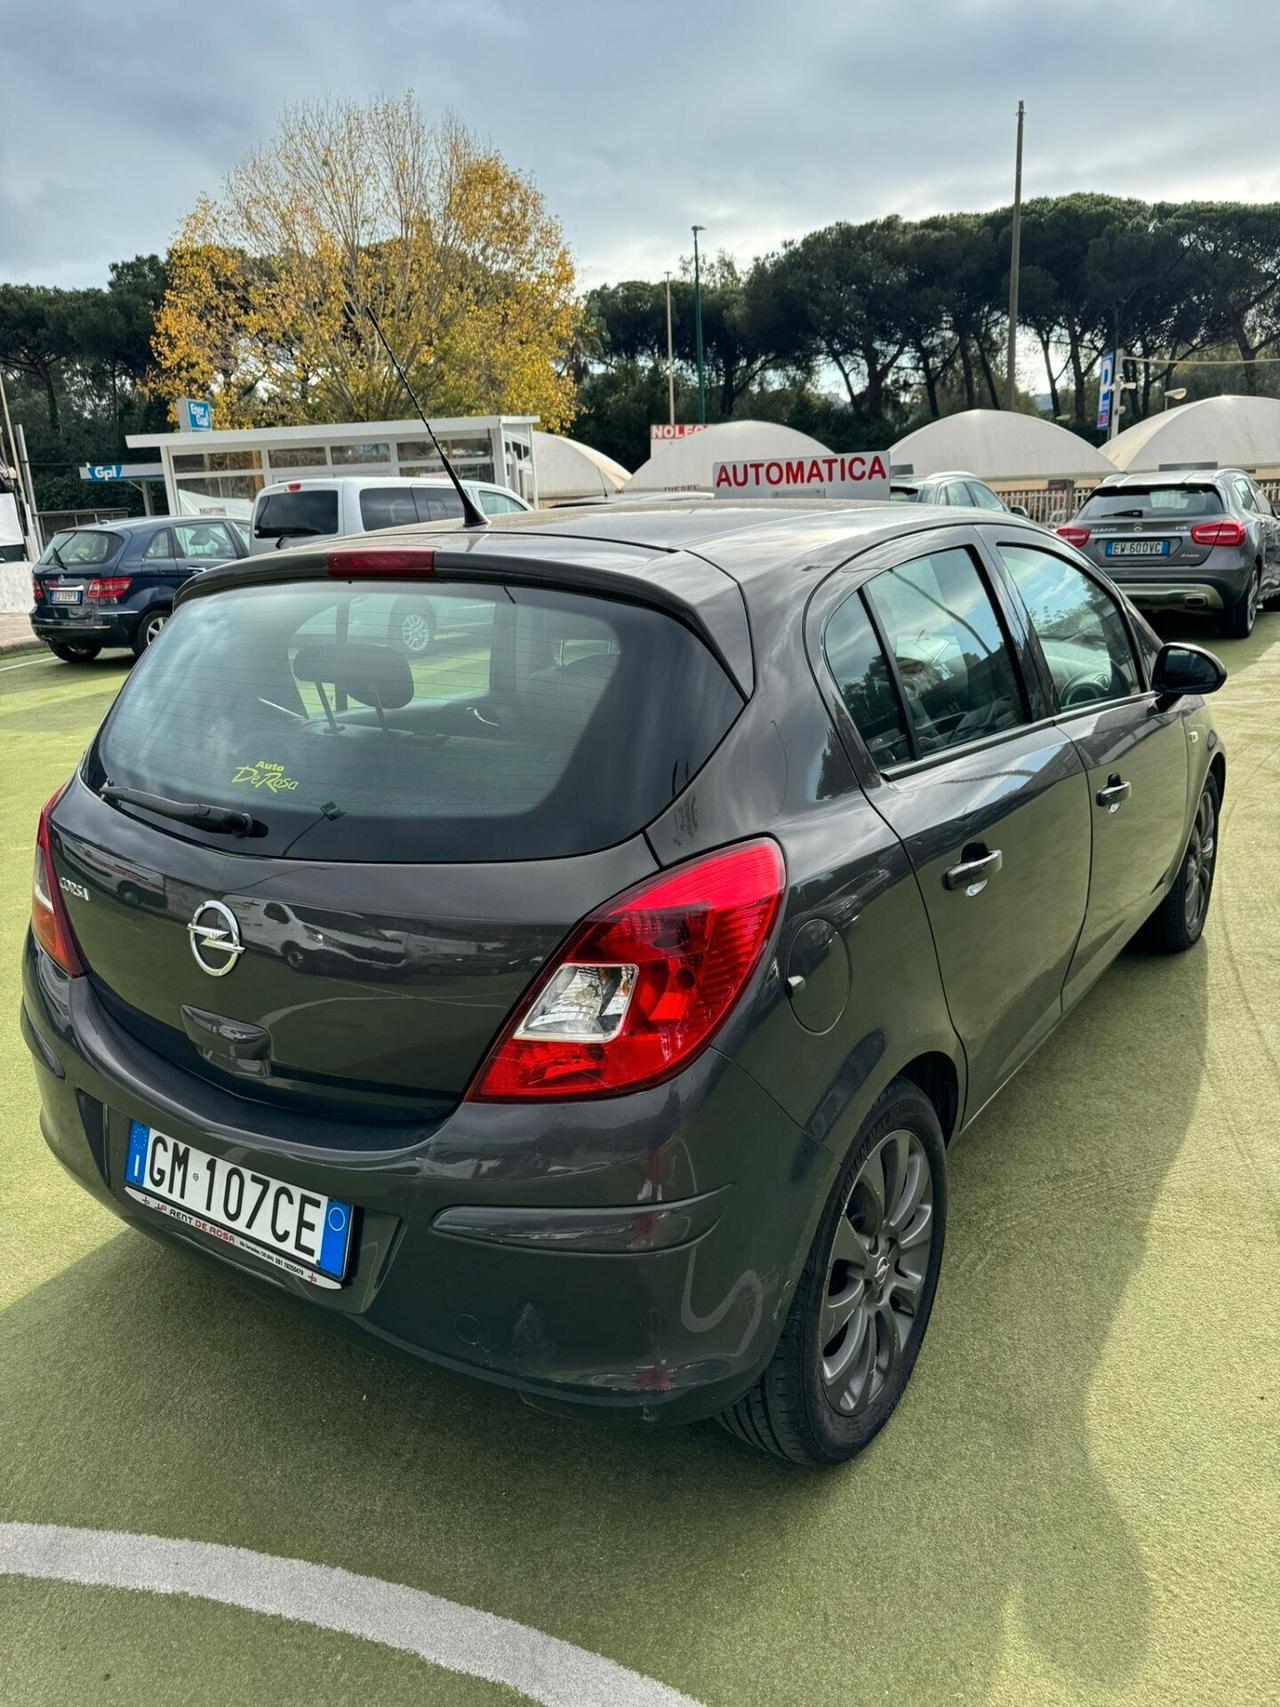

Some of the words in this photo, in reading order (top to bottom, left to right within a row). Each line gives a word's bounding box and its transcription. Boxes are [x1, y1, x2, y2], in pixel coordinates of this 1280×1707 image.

[94, 466, 118, 481] Gpl
[716, 455, 887, 488] AUTOMATICA
[255, 760, 284, 772] Auto
[149, 1135, 191, 1200] GM
[205, 1157, 322, 1258] 107CE
[169, 1208, 194, 1224] RENT
[195, 1219, 208, 1232] DE
[209, 1226, 235, 1243] ROSA
